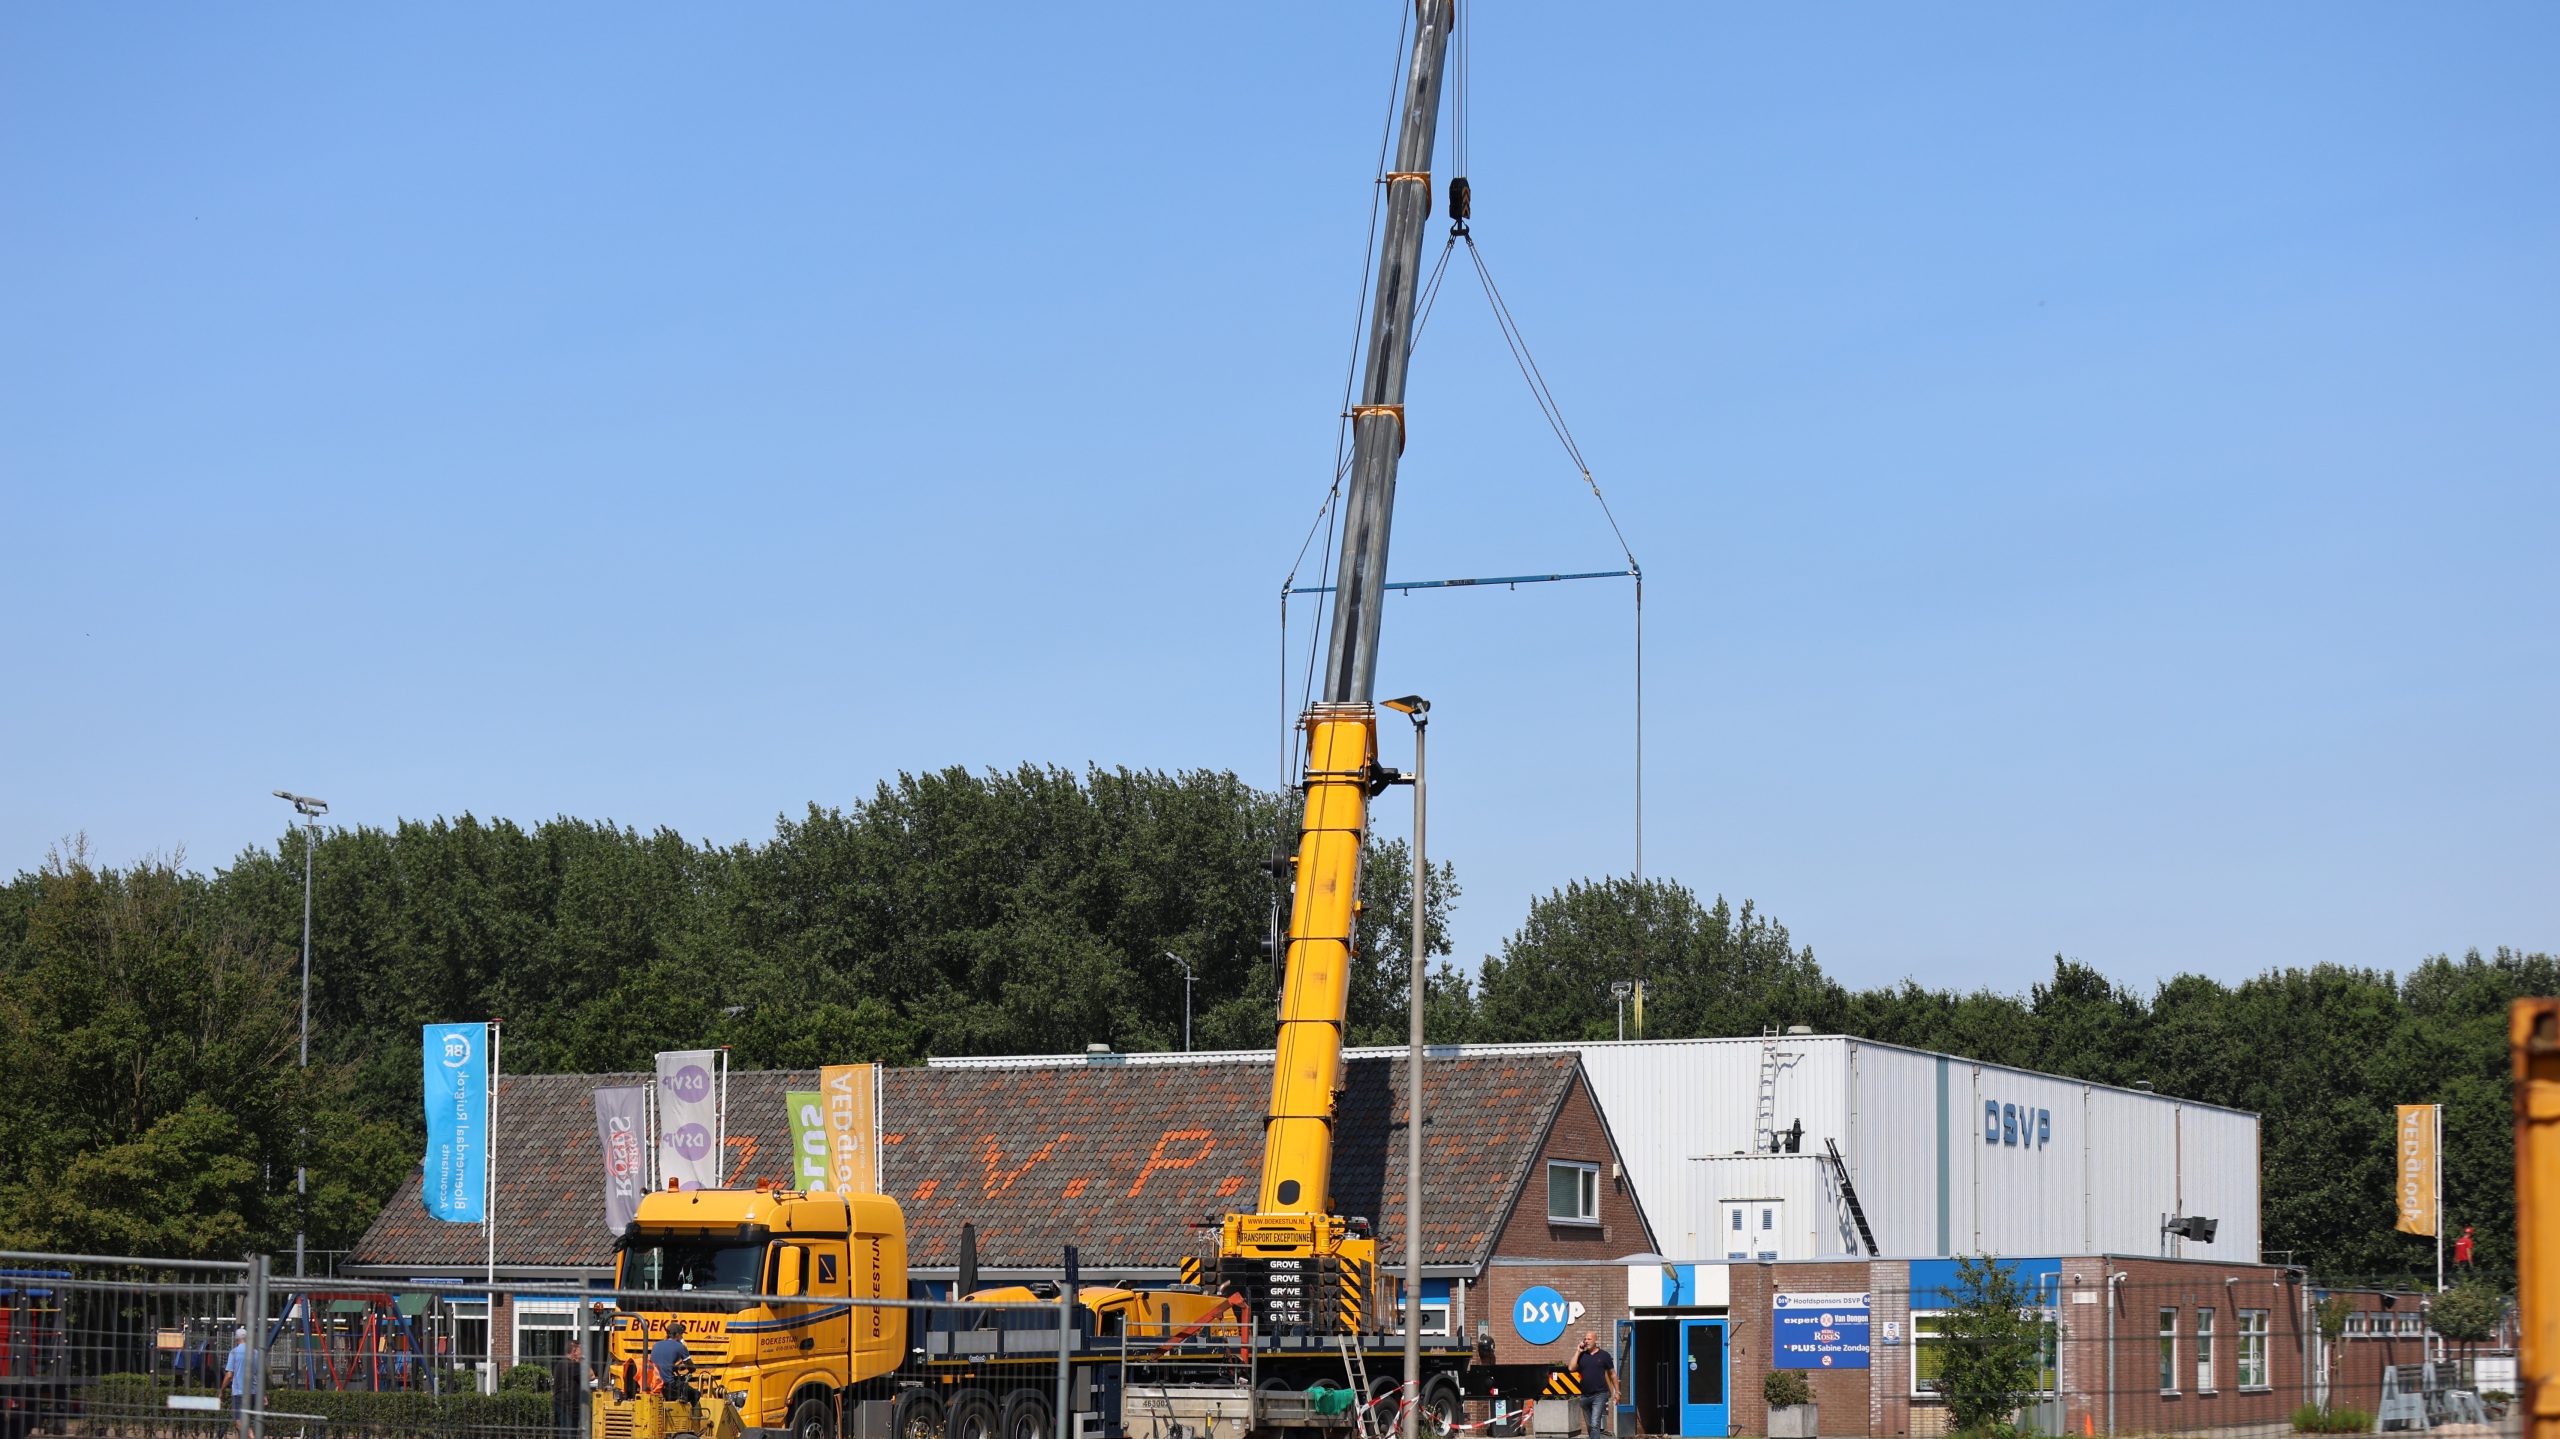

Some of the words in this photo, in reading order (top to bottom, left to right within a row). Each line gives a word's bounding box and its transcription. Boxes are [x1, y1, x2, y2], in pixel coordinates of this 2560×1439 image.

[1985, 1099, 2050, 1151] DSVP
[1242, 1232, 1272, 1243] TRANSPORT
[1274, 1232, 1313, 1243] EXCEPTIONNEL
[872, 1235, 881, 1338] BOEESTIJN
[1793, 1297, 1841, 1305] Hoofdsponsors
[1523, 1301, 1586, 1325] DSVP
[1847, 1315, 1868, 1323] Dongen
[631, 1319, 720, 1334] BOEKSTIJN
[1791, 1344, 1816, 1352] PLUS
[1818, 1344, 1841, 1352] Sabine
[1843, 1344, 1870, 1353] Zondag
